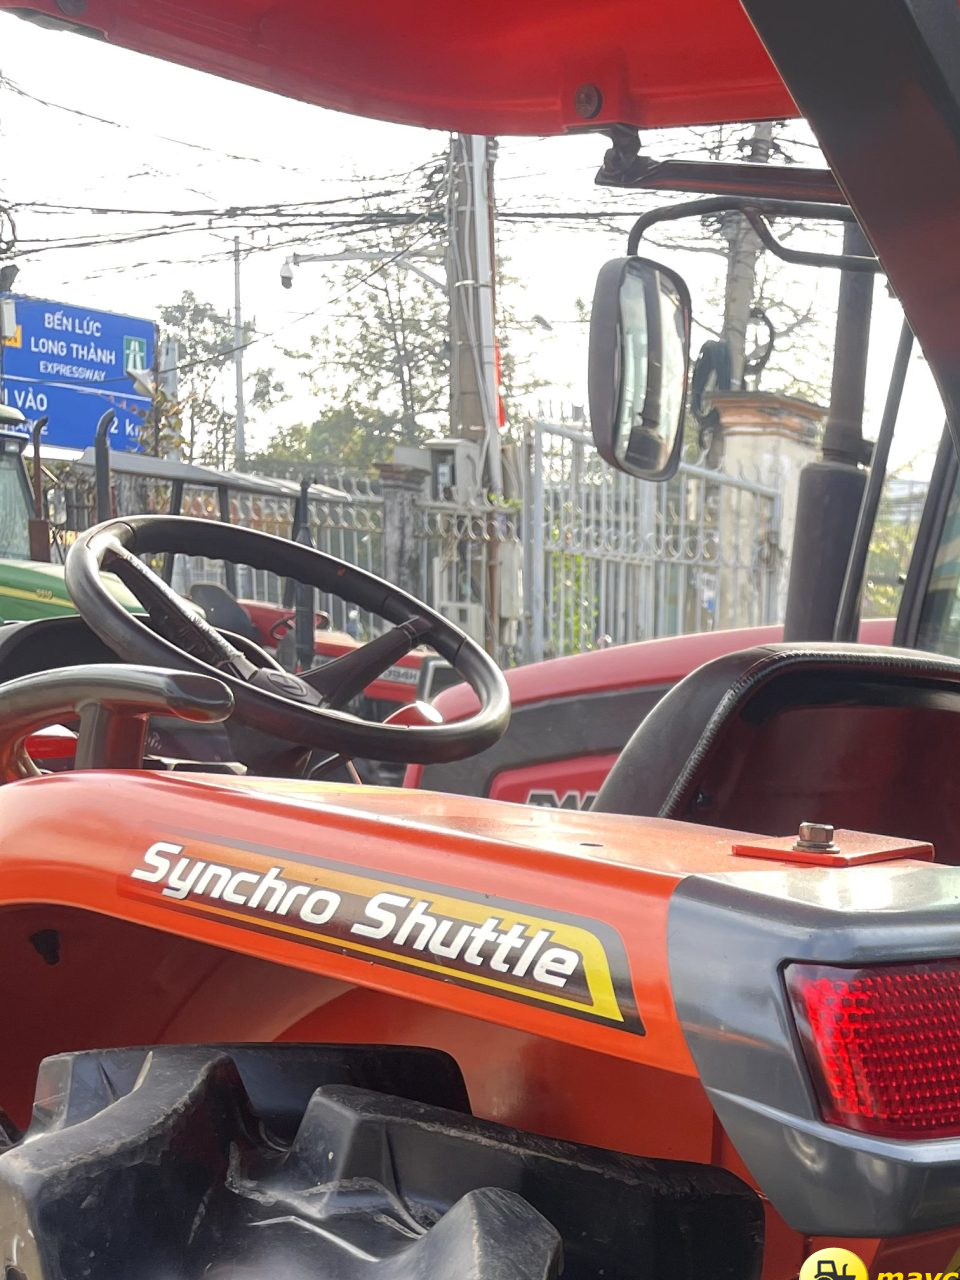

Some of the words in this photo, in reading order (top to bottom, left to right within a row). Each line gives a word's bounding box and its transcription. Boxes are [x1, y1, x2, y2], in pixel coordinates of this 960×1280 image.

[44, 310, 72, 332] BẾN
[75, 316, 102, 337] LỨC
[30, 336, 67, 357] LONG
[70, 342, 116, 365] THÀNH
[39, 360, 106, 382] EXPRESSWAY
[13, 386, 48, 412] VÀO
[131, 841, 342, 926] Synchro
[351, 892, 581, 988] Shuttle
